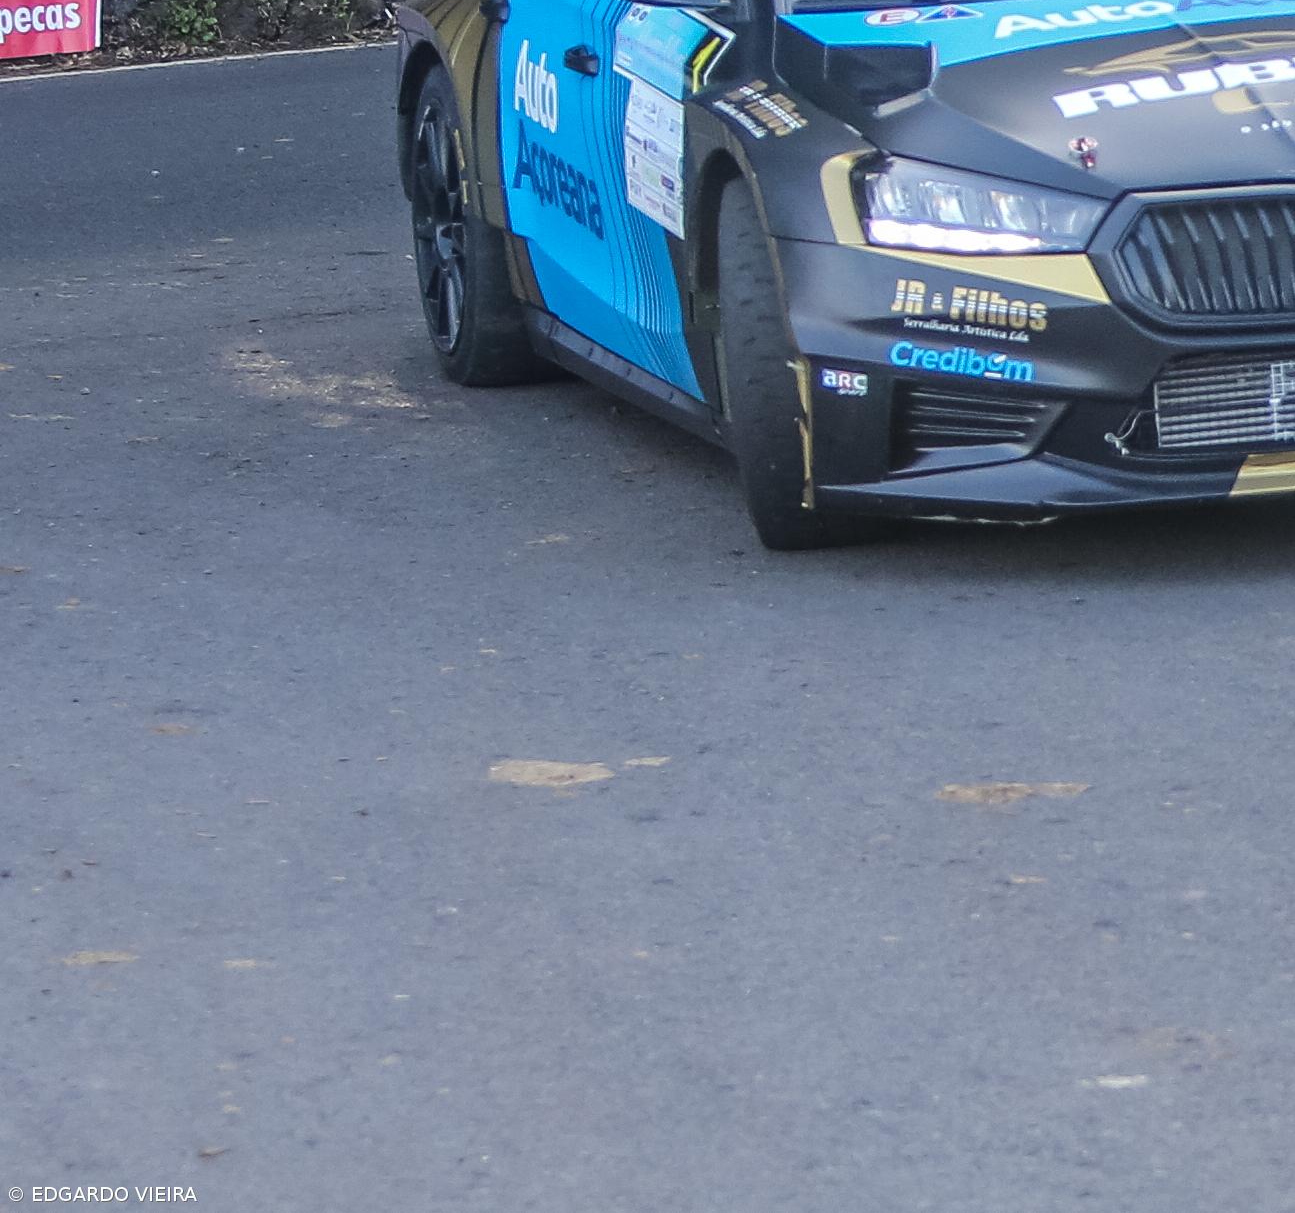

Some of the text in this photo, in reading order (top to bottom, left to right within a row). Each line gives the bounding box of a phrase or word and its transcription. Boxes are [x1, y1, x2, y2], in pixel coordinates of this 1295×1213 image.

[0, 2, 82, 44] pecas
[994, 0, 1175, 39] Auto
[514, 39, 559, 134] Auto
[891, 278, 927, 315] JR
[949, 285, 1048, 333] Filhos
